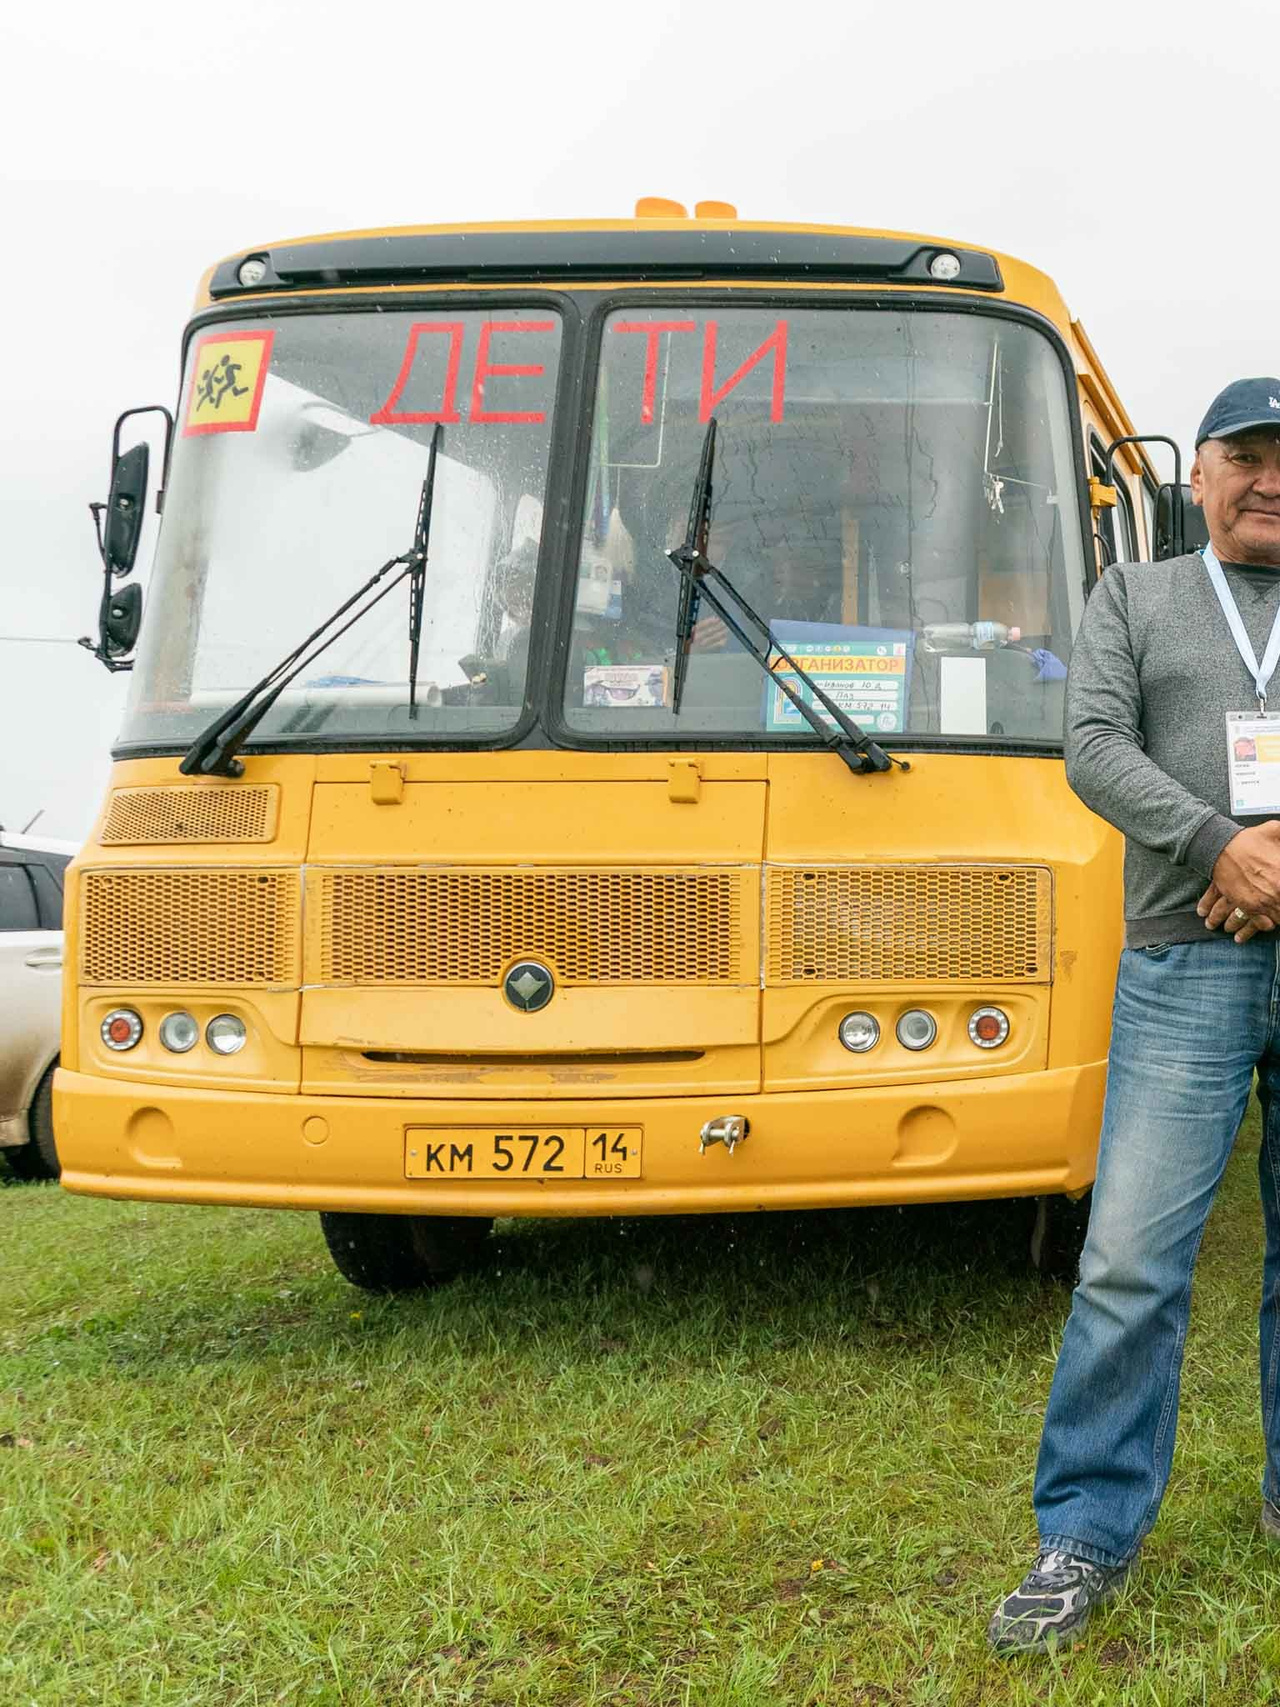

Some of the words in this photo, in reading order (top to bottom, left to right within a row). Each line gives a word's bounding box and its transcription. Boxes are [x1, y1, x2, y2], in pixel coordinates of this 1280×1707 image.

[426, 1143, 474, 1172] КМ
[492, 1135, 565, 1171] 572
[592, 1133, 628, 1161] 14
[595, 1163, 623, 1174] RUS
